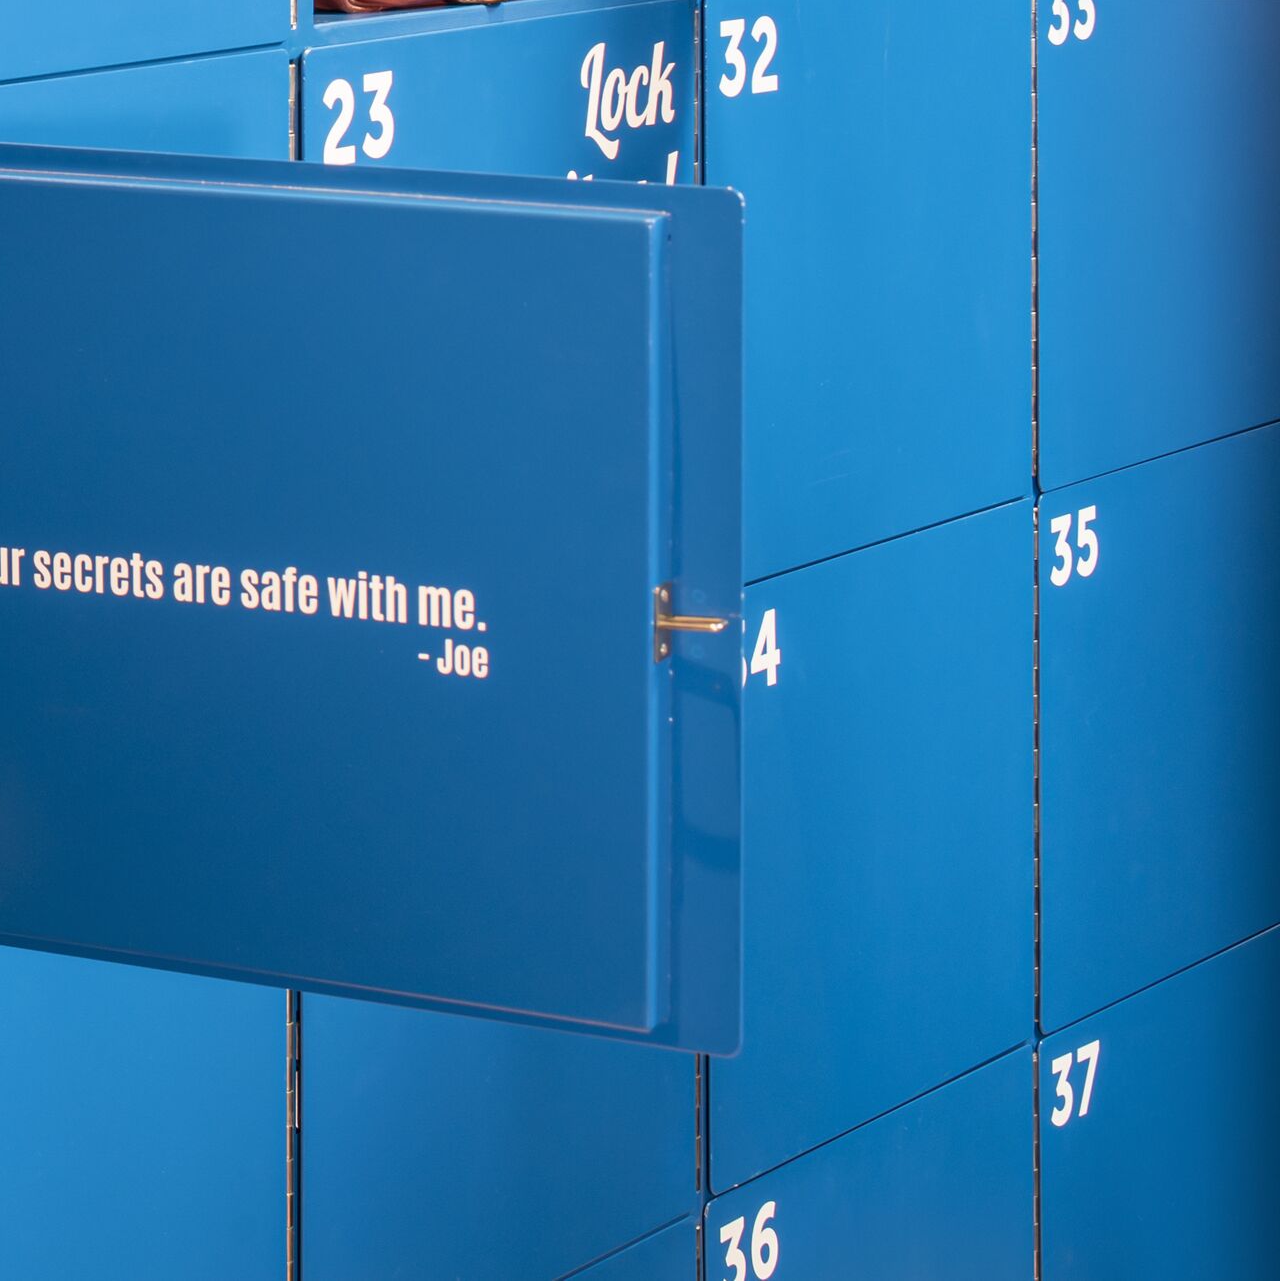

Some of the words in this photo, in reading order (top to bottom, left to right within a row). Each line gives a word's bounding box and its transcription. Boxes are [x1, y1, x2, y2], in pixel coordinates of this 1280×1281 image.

[718, 15, 779, 98] 32
[322, 69, 395, 167] 23
[580, 40, 676, 160] Lock
[1050, 504, 1099, 587] 35
[33, 550, 164, 600] secrets
[173, 561, 231, 606] are
[240, 566, 318, 615] safe
[327, 570, 408, 624] with
[418, 585, 487, 632] me.
[742, 608, 781, 687] 4
[1050, 1039, 1100, 1127] 37
[719, 1200, 779, 1281] 36
